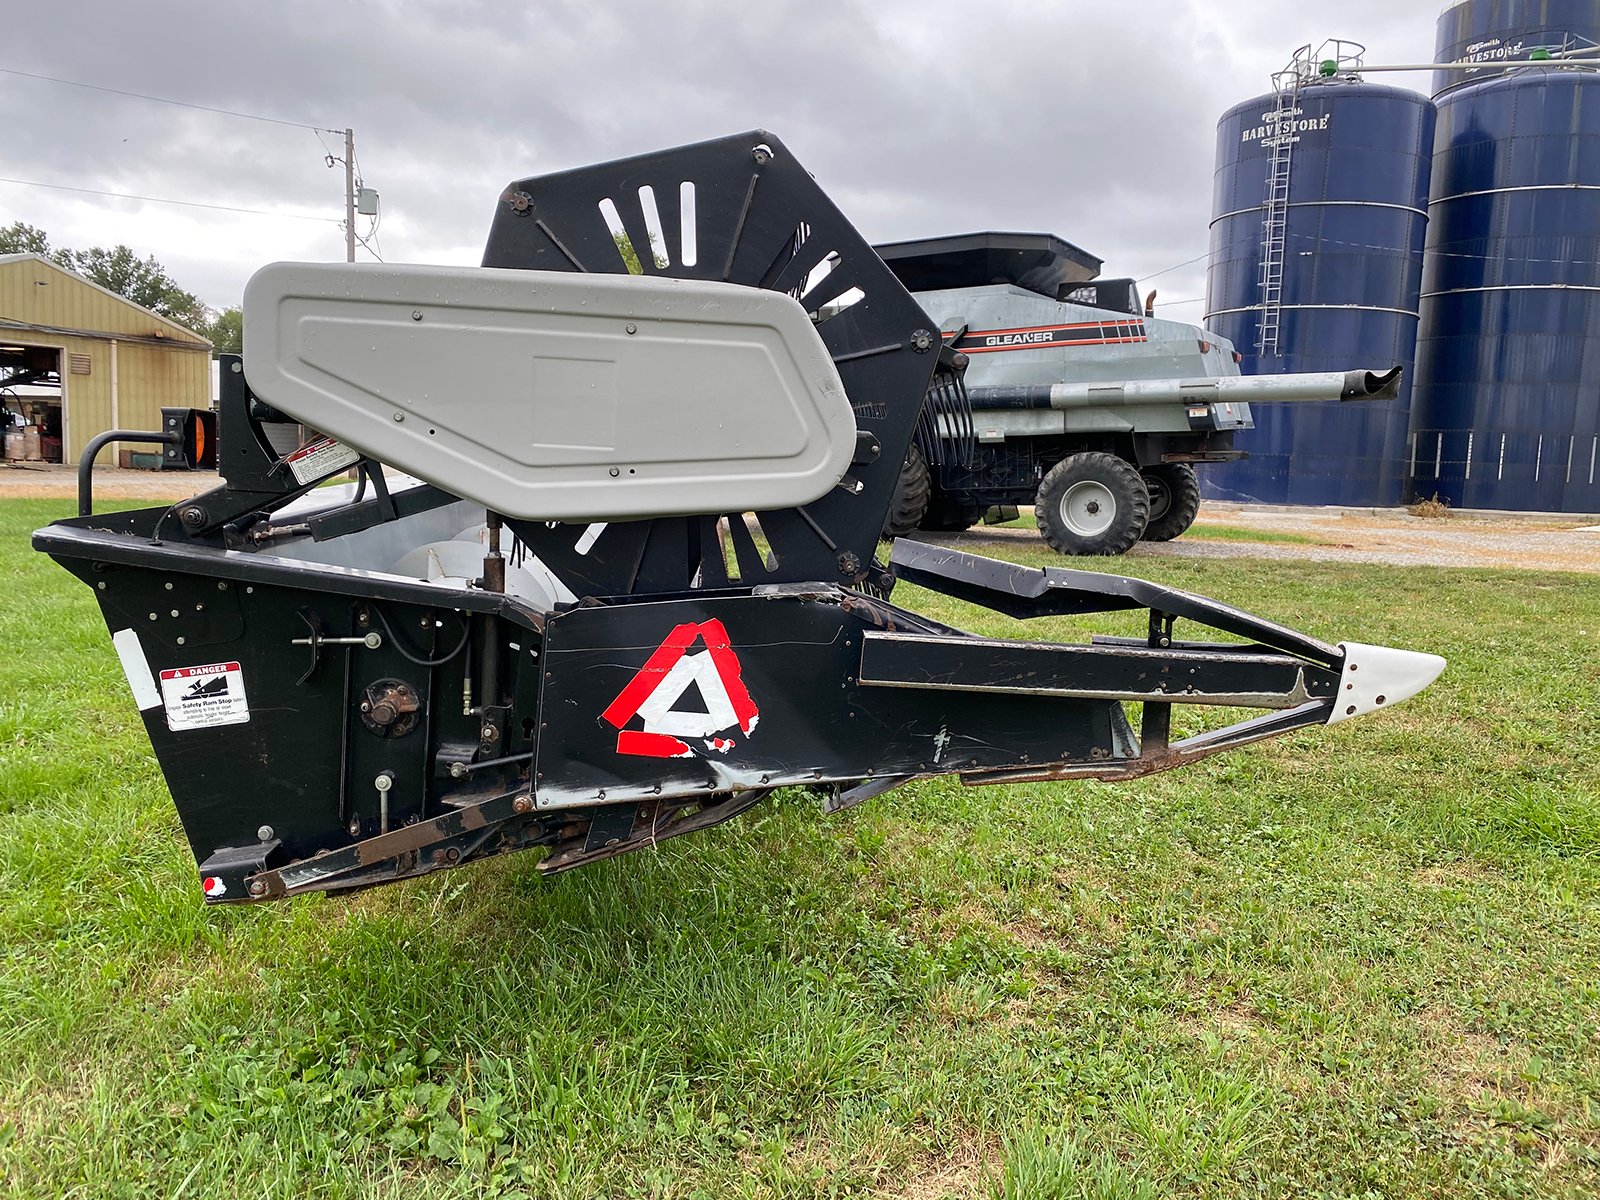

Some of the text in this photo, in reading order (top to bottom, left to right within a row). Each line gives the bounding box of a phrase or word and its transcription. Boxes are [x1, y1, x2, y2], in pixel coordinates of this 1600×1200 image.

[1450, 45, 1521, 64] ARVESTORE
[986, 331, 1053, 346] GLEANER
[189, 665, 227, 676] DANGER
[182, 701, 201, 709] Safety
